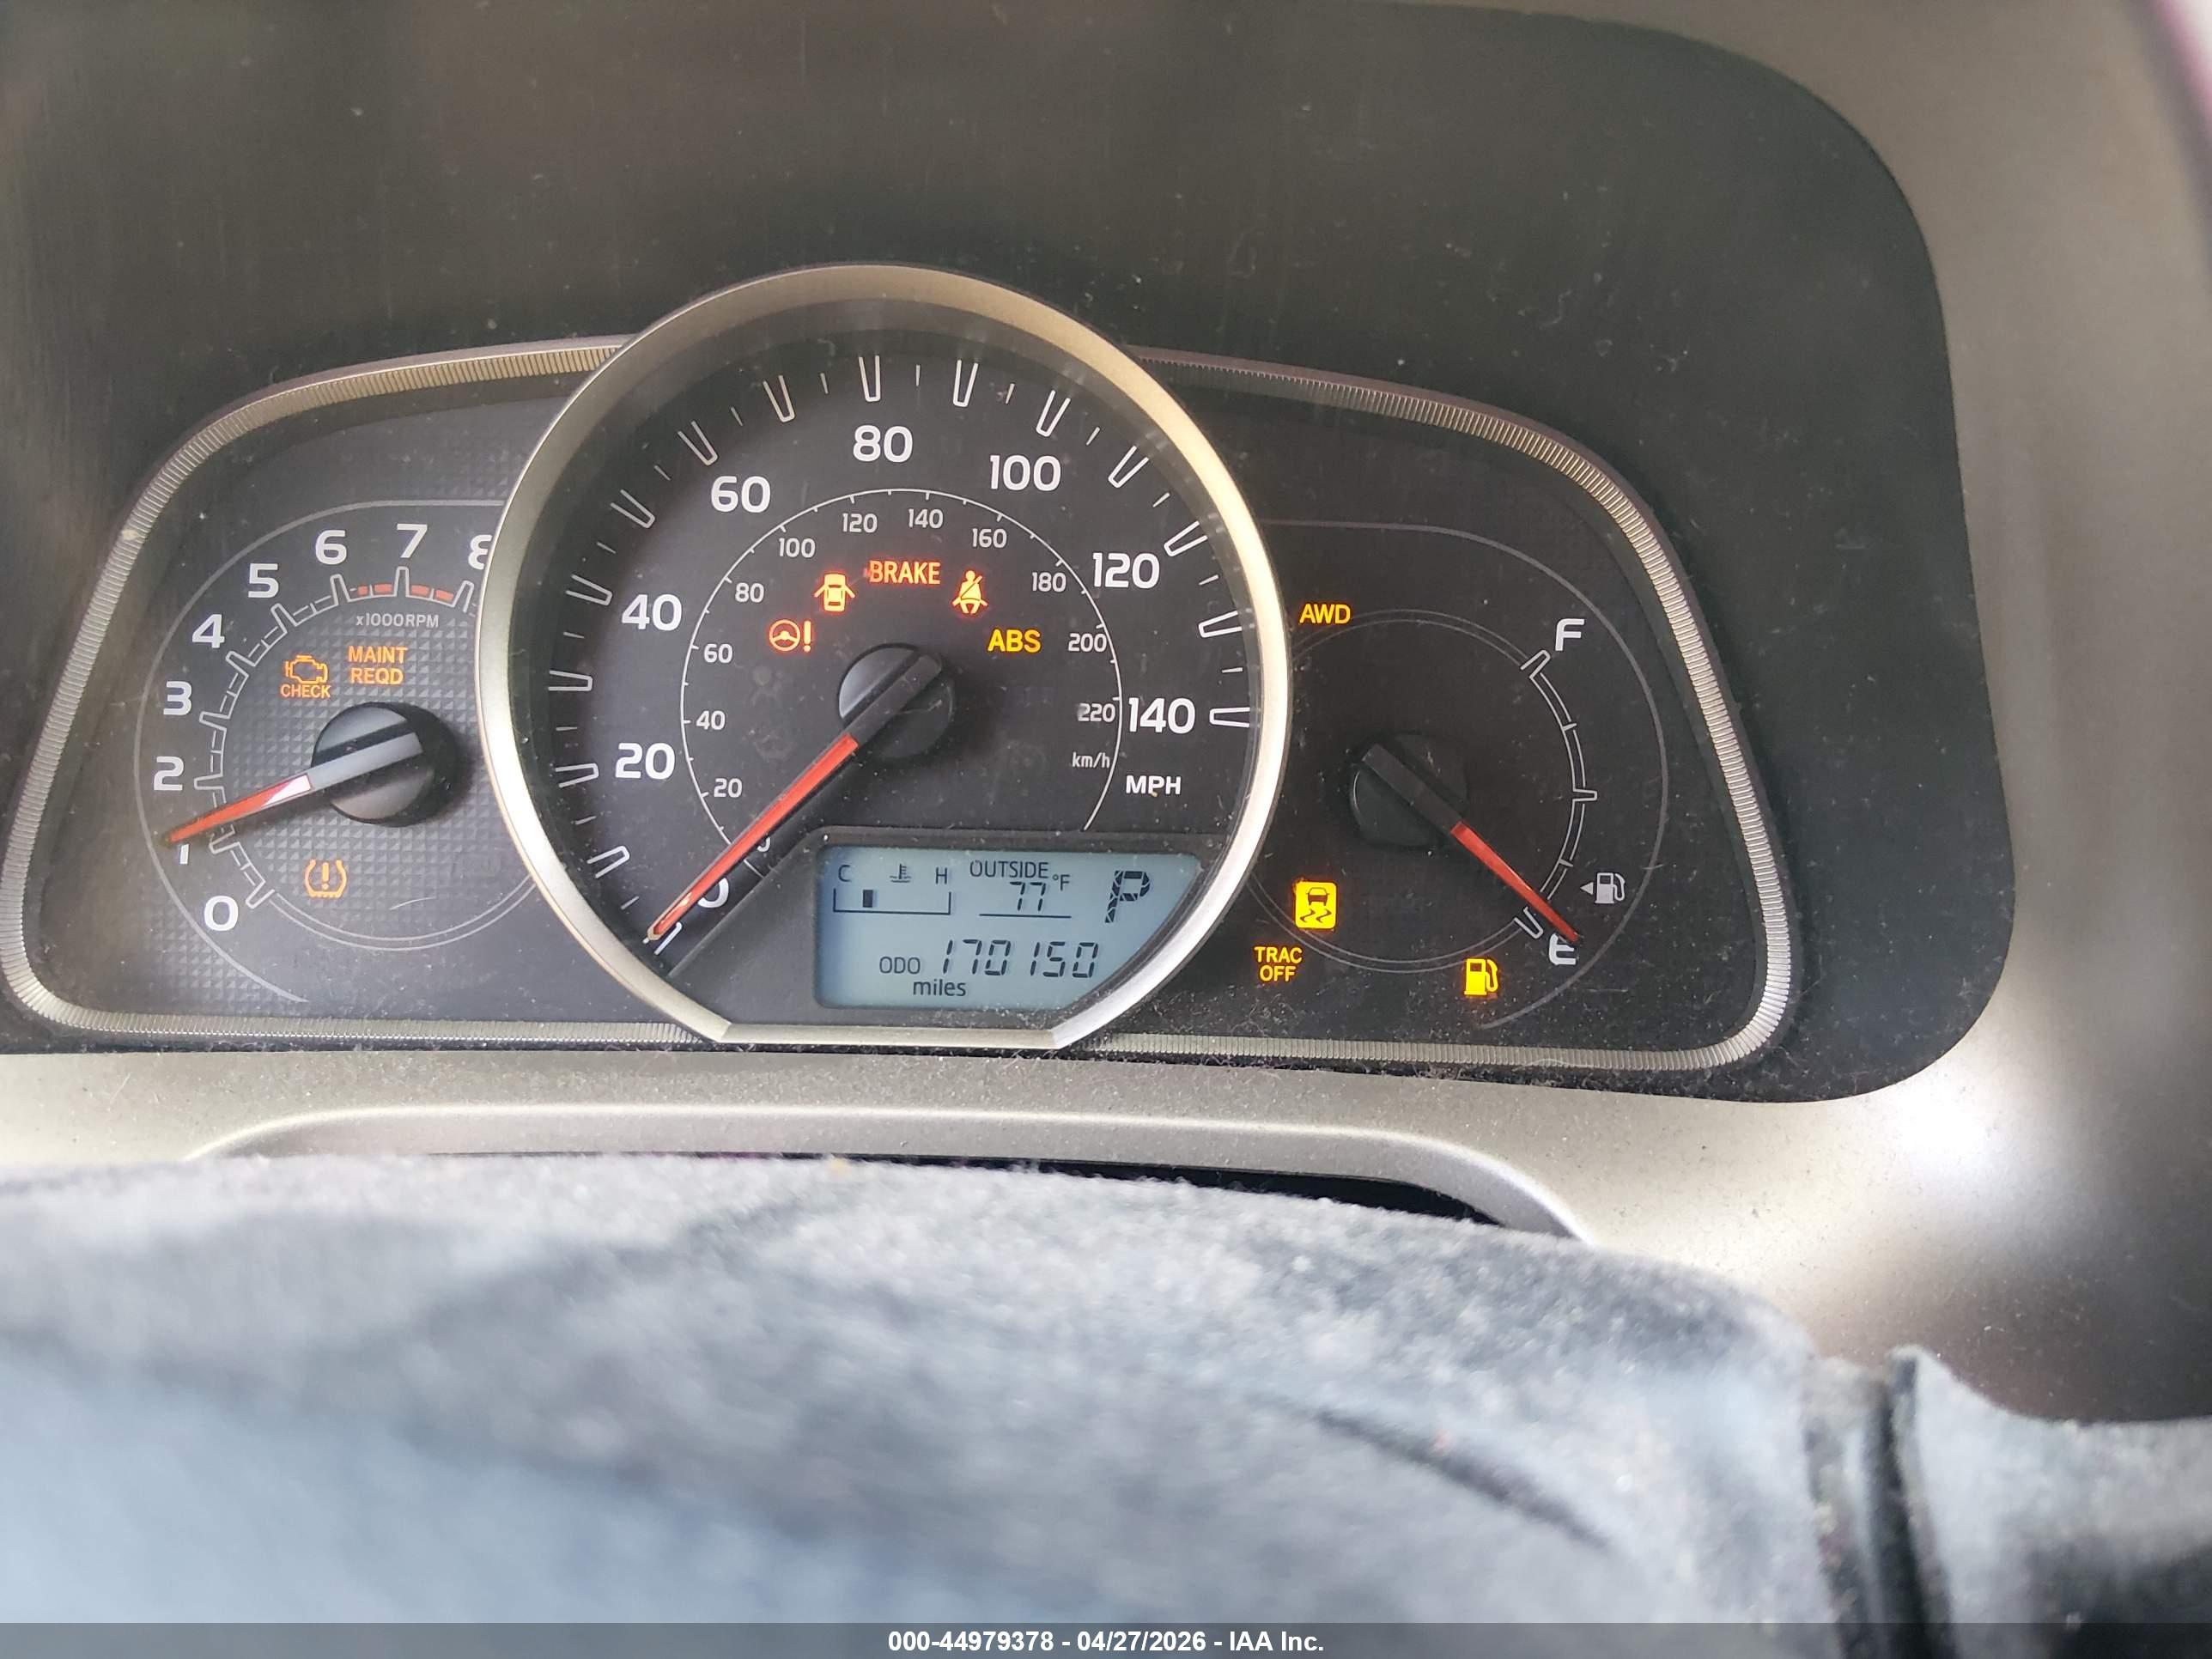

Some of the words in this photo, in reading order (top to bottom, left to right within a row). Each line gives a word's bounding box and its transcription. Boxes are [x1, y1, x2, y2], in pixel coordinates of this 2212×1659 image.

[853, 425, 914, 463] 80
[990, 455, 1061, 491] 100
[710, 476, 771, 513] 60
[842, 514, 878, 533] 120
[908, 508, 944, 529] 140
[315, 530, 347, 565] 6
[397, 524, 428, 558] 7
[779, 538, 816, 558] 100
[972, 528, 1007, 548] 160
[247, 563, 279, 598] 5
[869, 561, 941, 585] BRAKE
[1092, 552, 1160, 589] 120
[1032, 572, 1066, 592] 180
[734, 583, 764, 603] 80
[621, 594, 683, 631] 40
[1299, 604, 1351, 623] AWD
[191, 614, 225, 648] 4
[988, 629, 1042, 653] ABS
[1555, 618, 1584, 651] F
[703, 643, 733, 664] 60
[1067, 633, 1107, 653] 200
[349, 647, 408, 665] MAINT
[350, 667, 404, 685] REQD
[163, 681, 192, 715] 3
[280, 684, 331, 699] CHECK
[696, 710, 726, 730] 40
[1078, 702, 1115, 723] 220
[1128, 697, 1195, 733] 140
[615, 743, 675, 779] 20
[1072, 751, 1110, 769] km/h
[154, 757, 184, 791] 2
[714, 778, 743, 798] 20
[1125, 775, 1182, 795] MPH
[838, 865, 851, 882] C
[935, 867, 948, 884] H
[969, 860, 1049, 879] OUTSIDE
[1010, 881, 1047, 911] 77
[1104, 871, 1151, 923] P
[204, 896, 239, 931] 0
[879, 957, 921, 974] ODO
[942, 939, 1098, 978] 170150
[1255, 946, 1303, 964] TRAC
[1259, 965, 1296, 982] OFF
[913, 979, 966, 997] miles
